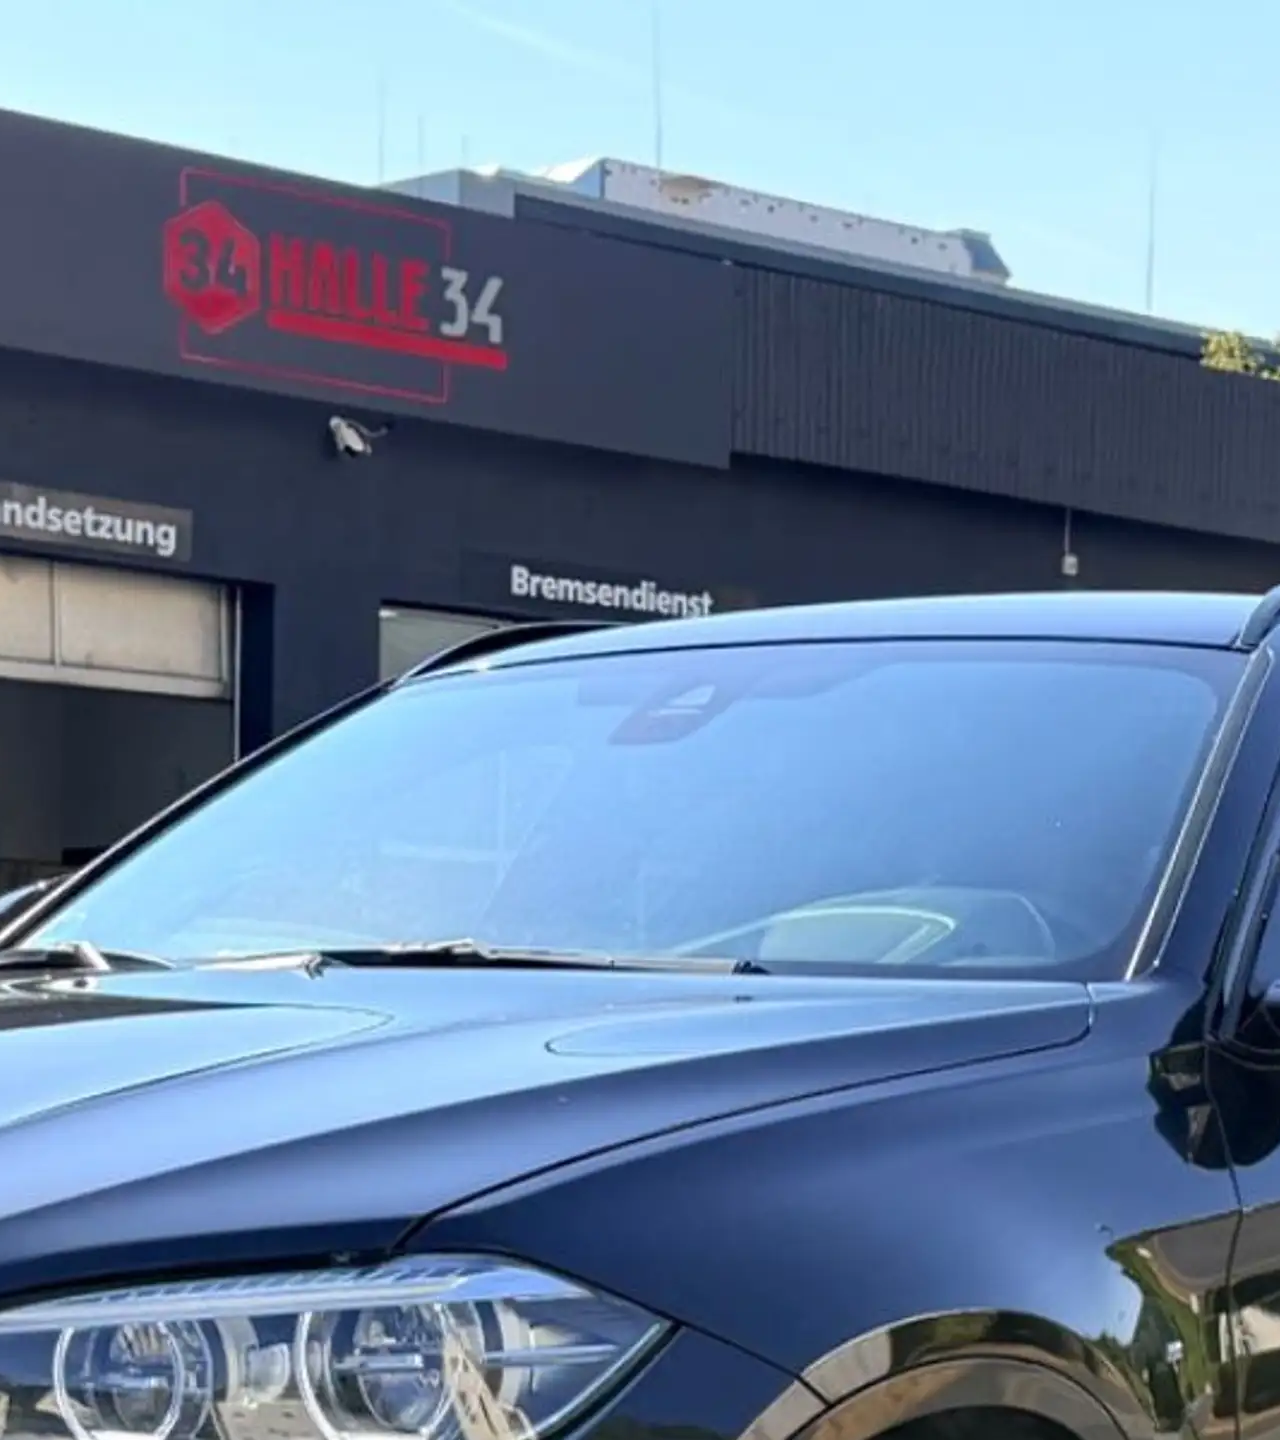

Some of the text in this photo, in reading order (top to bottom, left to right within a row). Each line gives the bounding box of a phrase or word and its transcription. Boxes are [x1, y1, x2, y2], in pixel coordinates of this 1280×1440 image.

[179, 227, 249, 297] 34
[271, 233, 504, 344] HALLE 34
[510, 564, 715, 618] Bremsendienst
